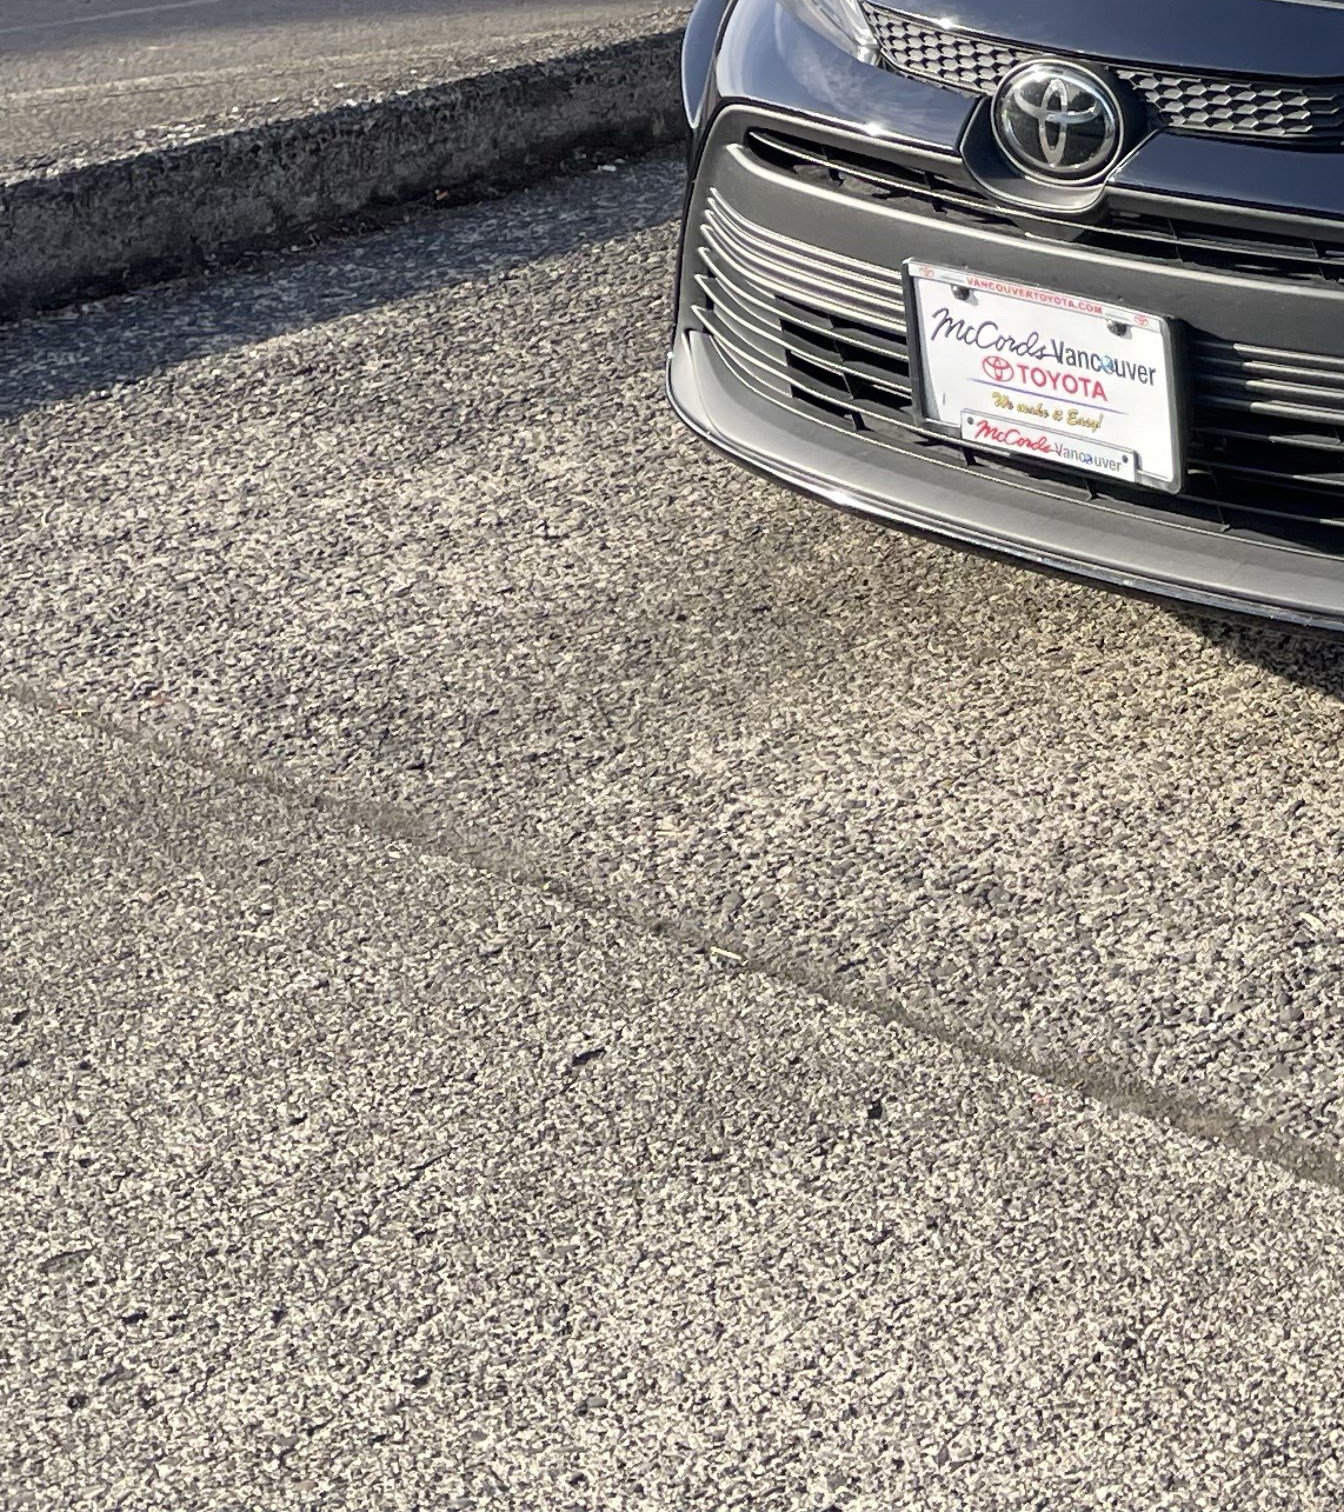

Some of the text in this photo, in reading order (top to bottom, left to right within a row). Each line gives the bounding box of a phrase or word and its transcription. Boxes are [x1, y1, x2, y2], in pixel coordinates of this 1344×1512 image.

[966, 274, 1103, 315] VANCOUVERTOYOTA.COM
[1050, 338, 1157, 387] Vancouver
[1016, 364, 1109, 403] TOYOTA
[1054, 441, 1123, 473] Vancouver
